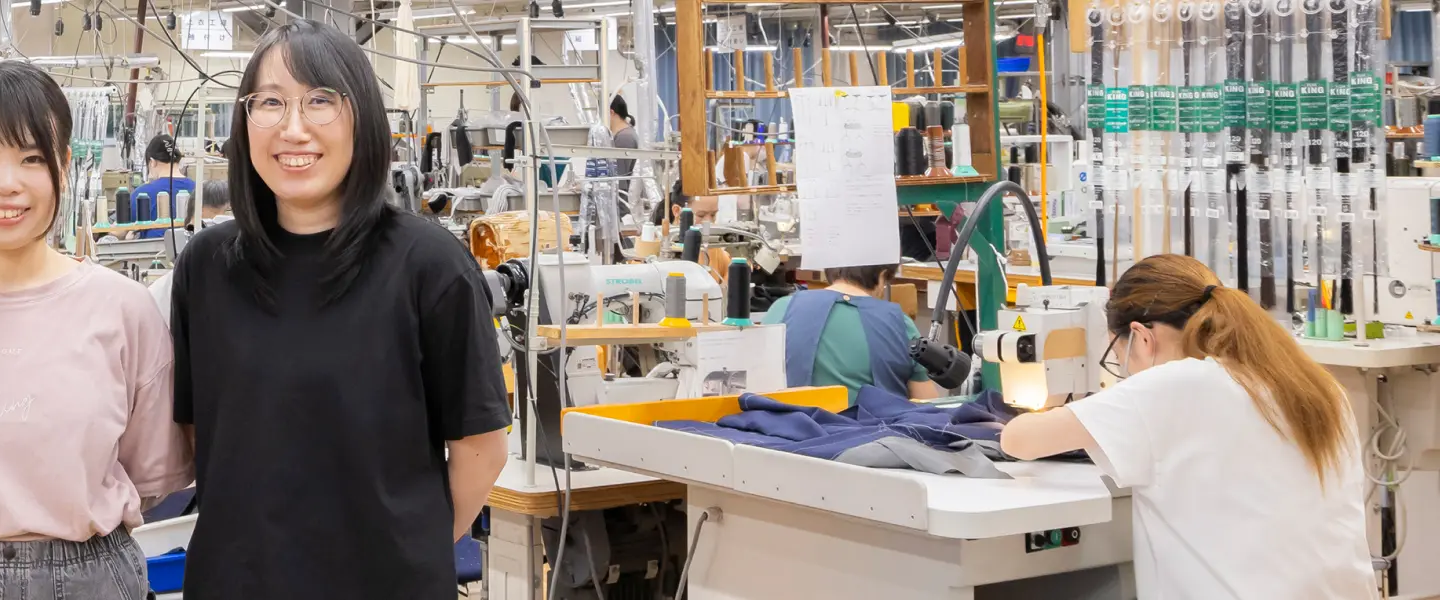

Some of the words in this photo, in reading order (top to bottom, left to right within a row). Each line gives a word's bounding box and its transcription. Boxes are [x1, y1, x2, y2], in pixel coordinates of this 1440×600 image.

[1351, 77, 1373, 85] KING
[1087, 89, 1104, 97] KING
[1129, 90, 1145, 98] KING
[1274, 90, 1295, 98] KING
[1301, 86, 1325, 94] KING
[1106, 93, 1127, 101] KING
[1201, 91, 1219, 99] KING
